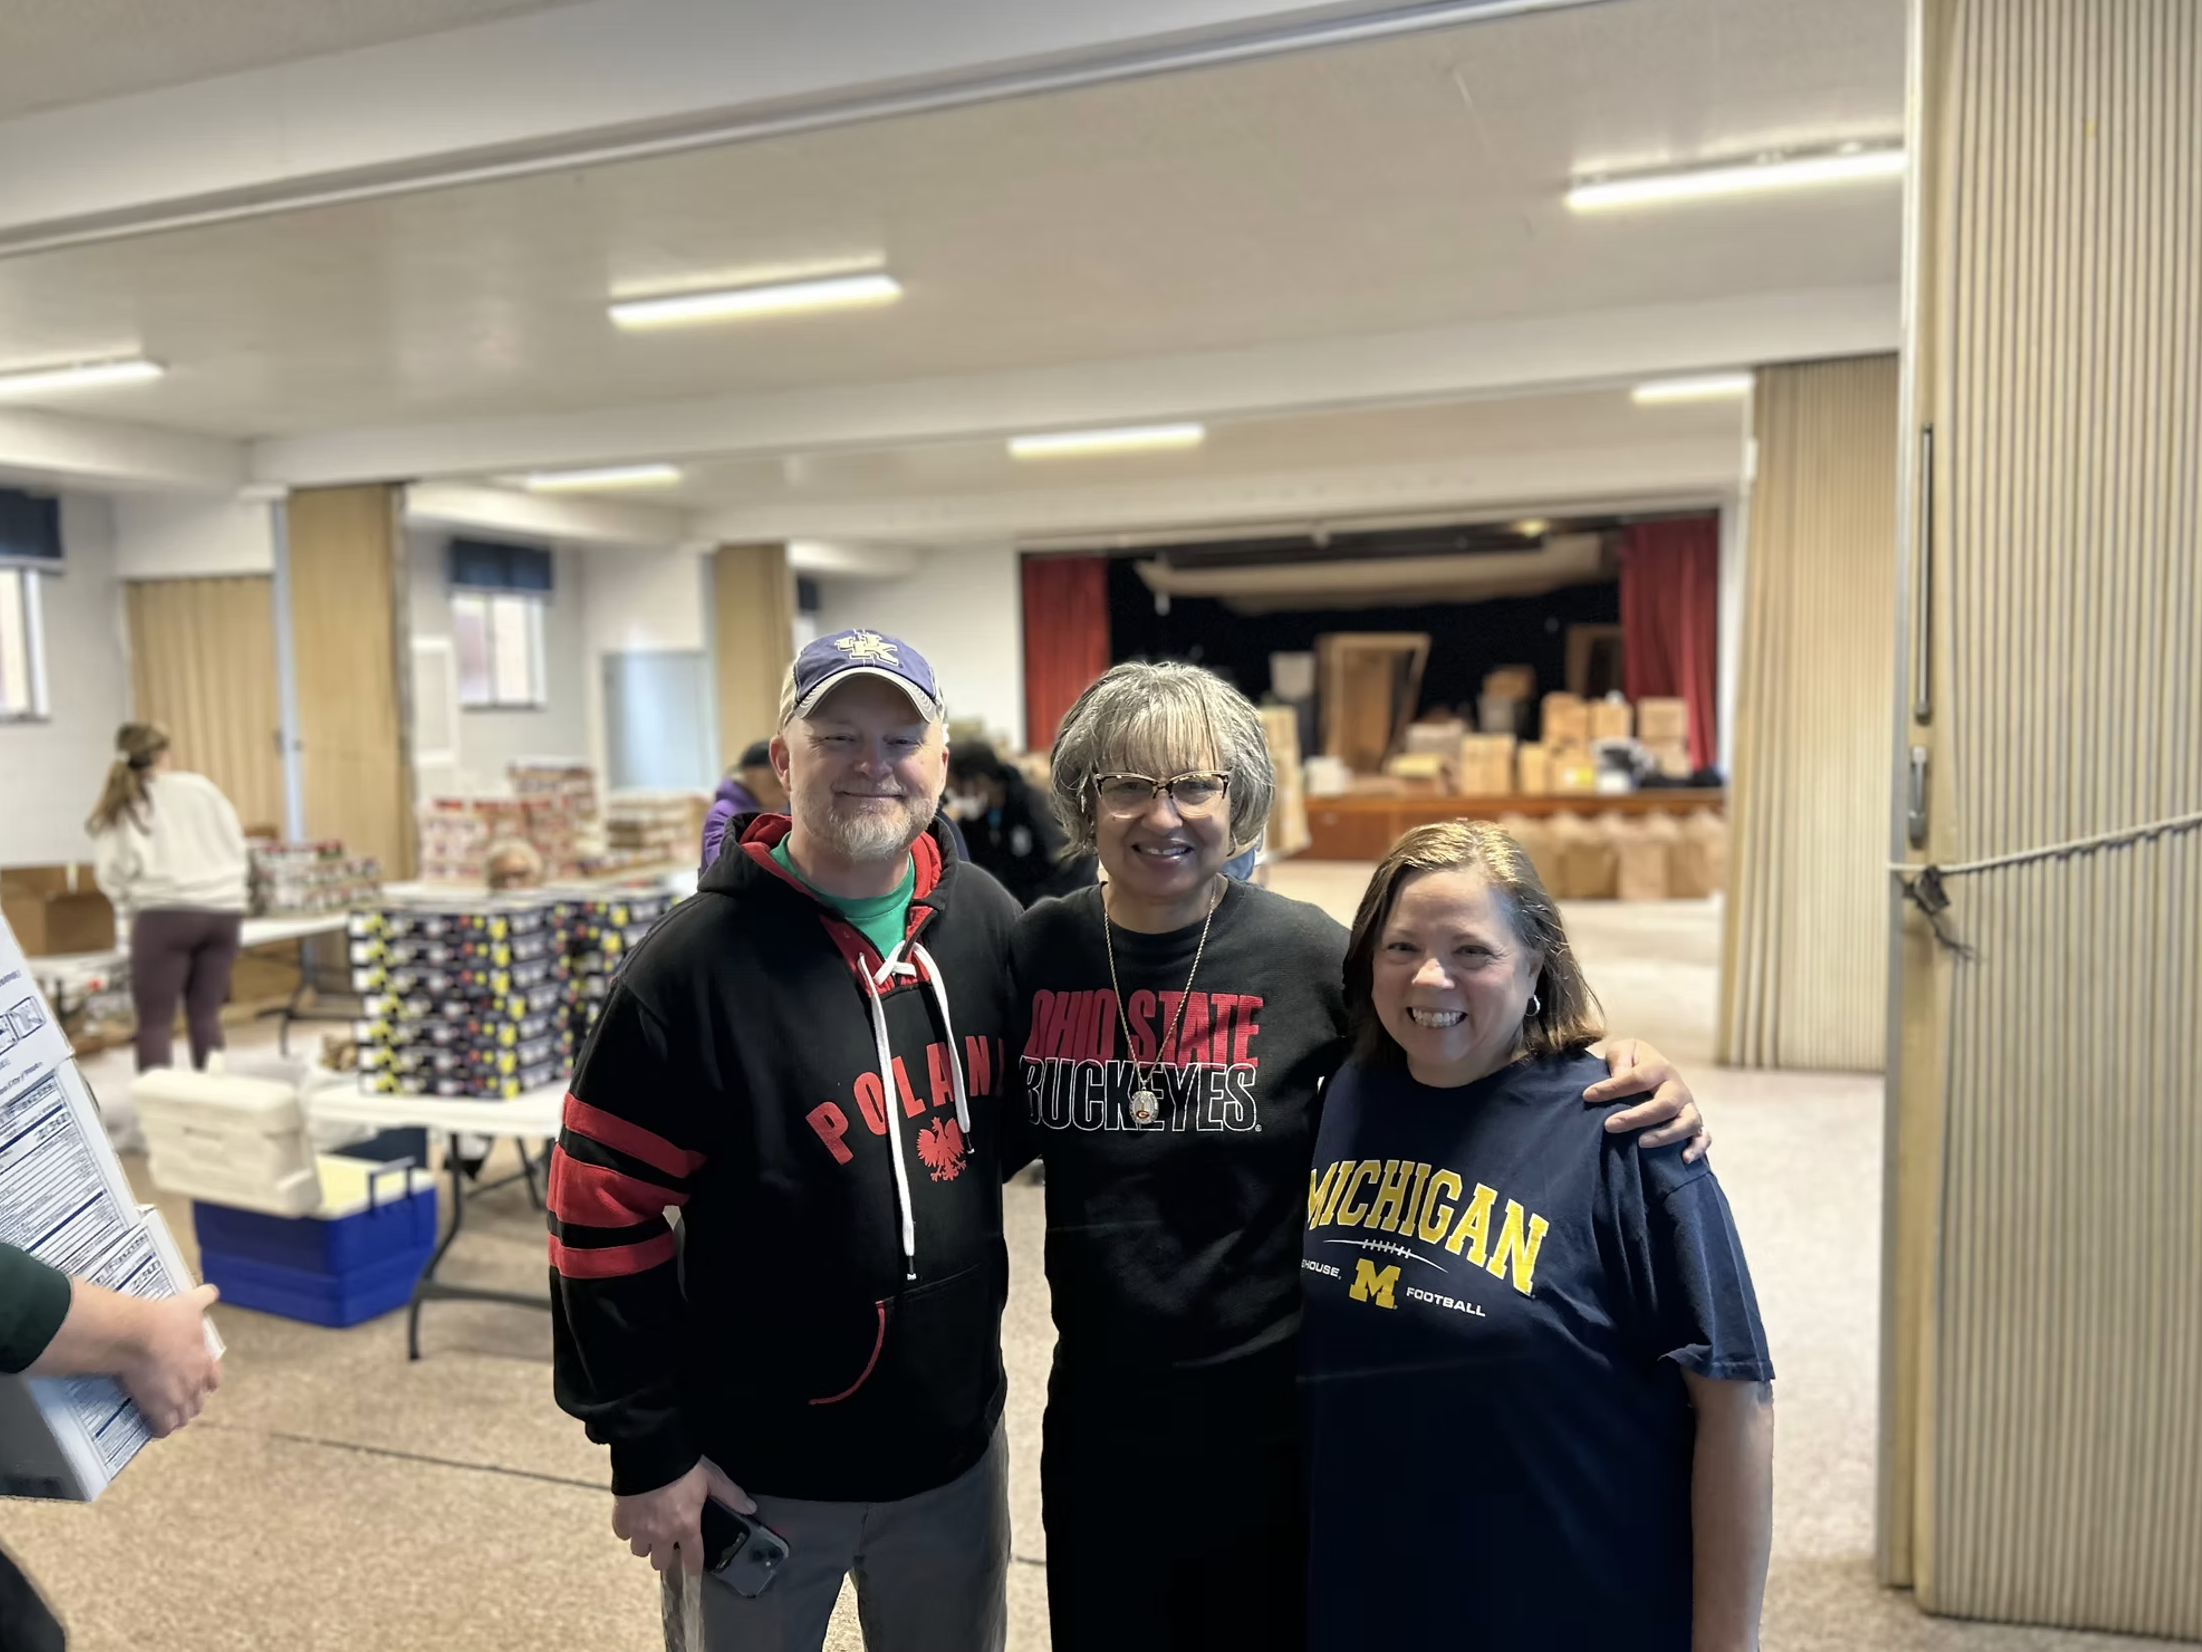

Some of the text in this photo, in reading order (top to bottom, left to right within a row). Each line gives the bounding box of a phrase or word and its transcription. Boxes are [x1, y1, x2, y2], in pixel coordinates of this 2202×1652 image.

[1023, 988, 1264, 1070] OHIO STATE
[1307, 1159, 1549, 1297] MICHIGAN
[1349, 1258, 1401, 1309] M
[1406, 1286, 1486, 1317] FOOTBALL
